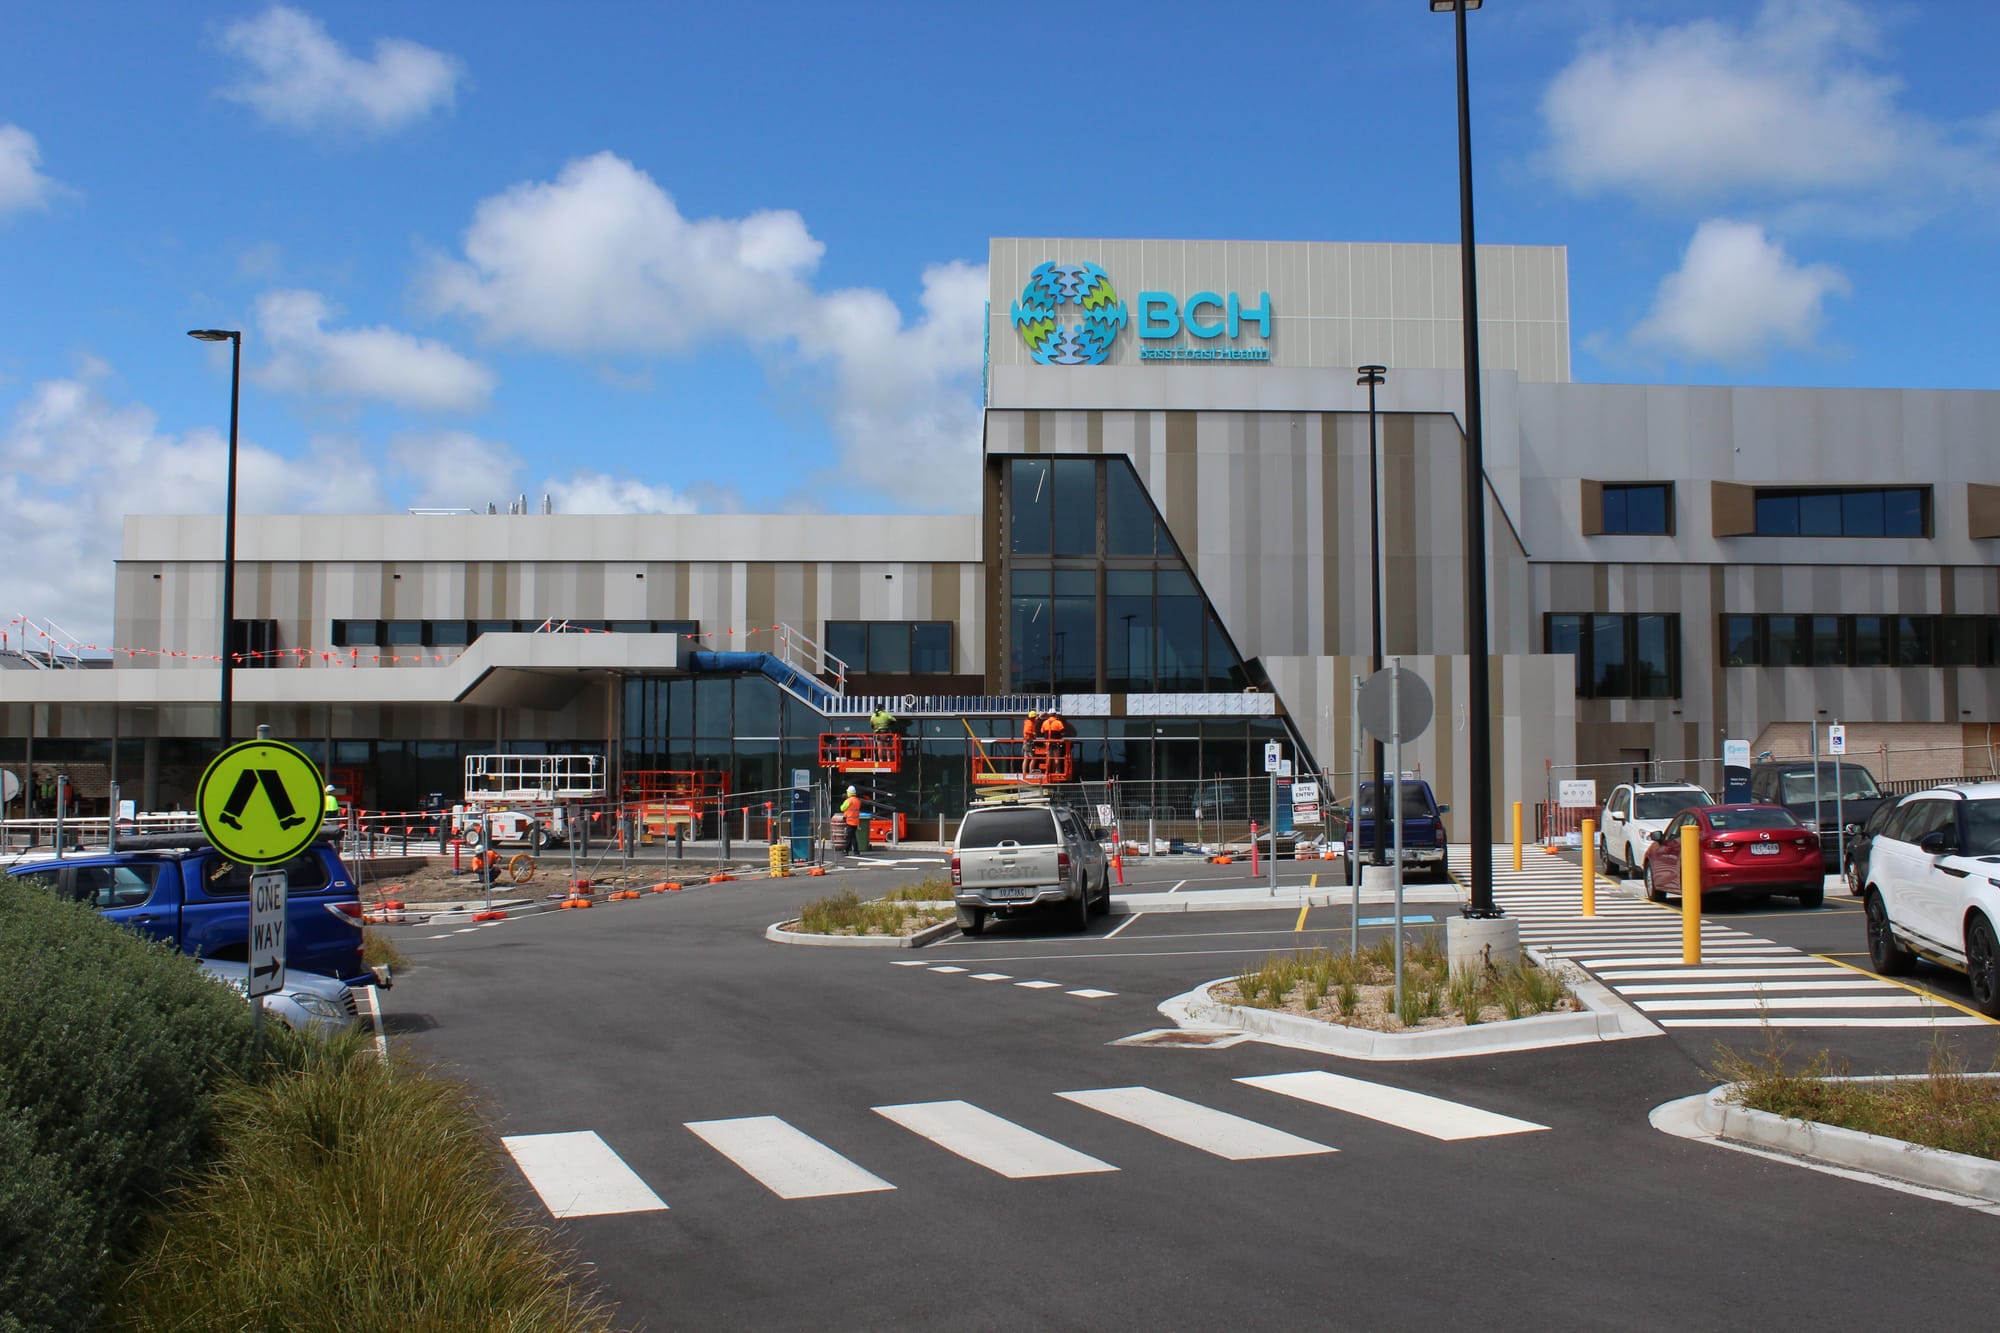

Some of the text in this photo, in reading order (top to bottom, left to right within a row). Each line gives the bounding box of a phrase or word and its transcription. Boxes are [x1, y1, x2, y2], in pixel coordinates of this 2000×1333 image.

[1138, 291, 1271, 339] BCH
[1139, 345, 1270, 360] Bass Coast Health
[977, 866, 1041, 880] TOYOTA
[257, 884, 281, 913] ONE
[254, 921, 282, 951] WAY
